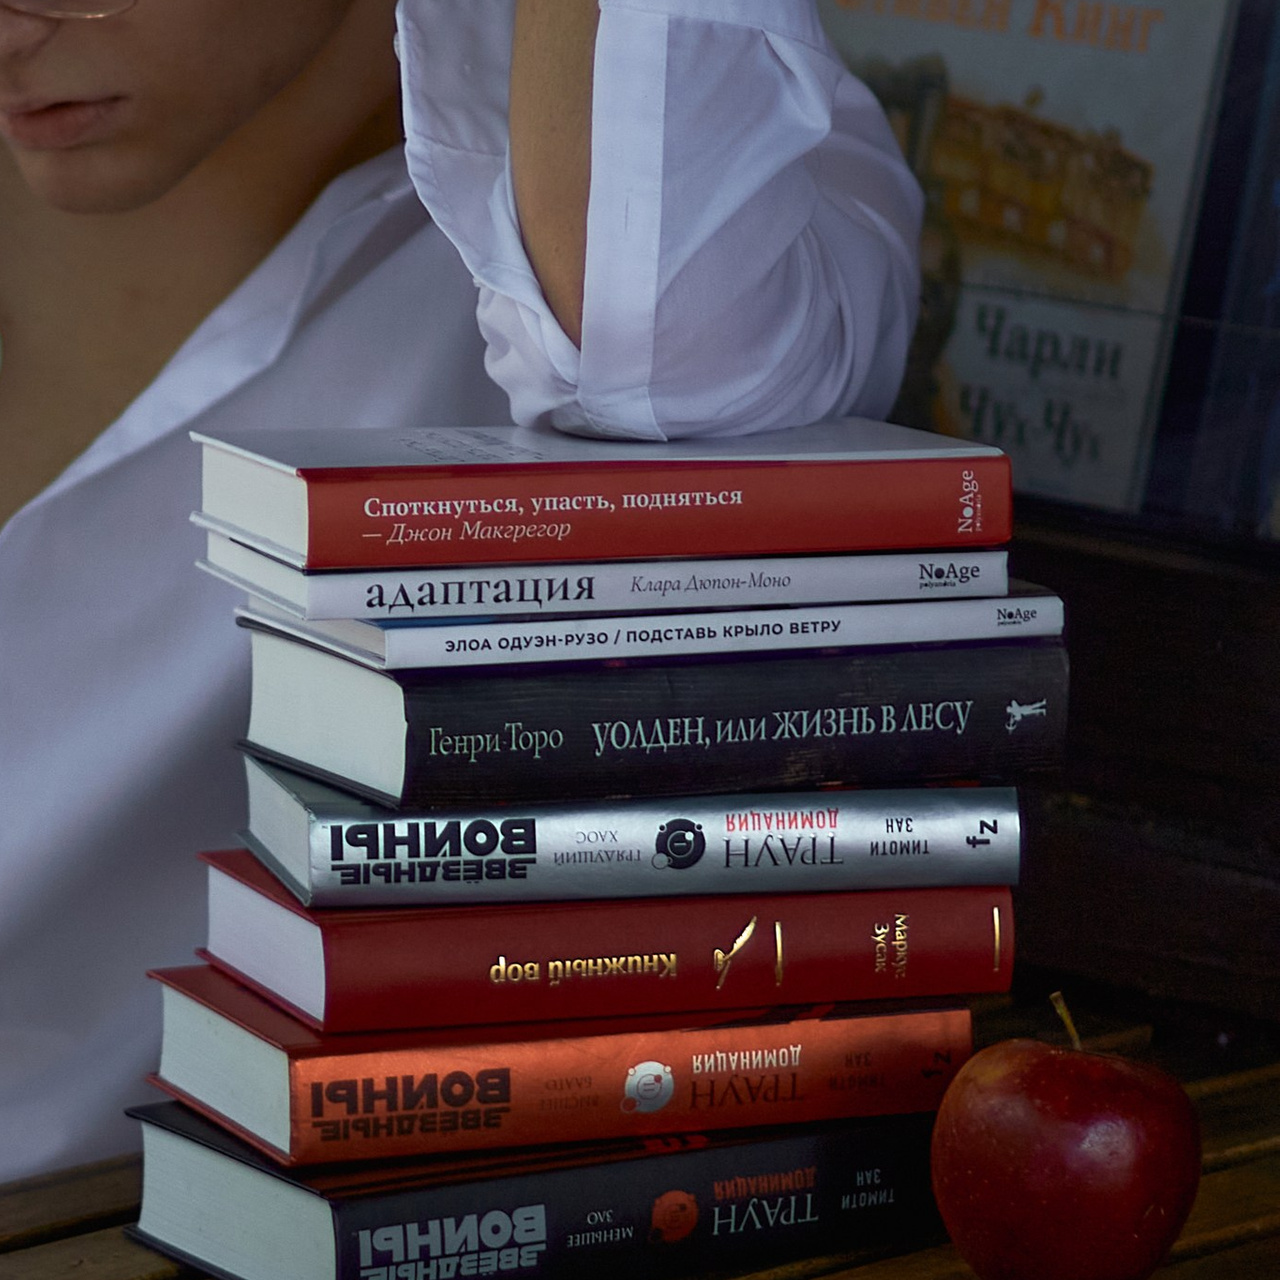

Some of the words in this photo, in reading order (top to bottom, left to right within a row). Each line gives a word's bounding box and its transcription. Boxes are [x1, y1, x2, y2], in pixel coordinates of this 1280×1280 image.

[976, 304, 1122, 379] Чарли
[363, 496, 524, 520] Споткнуться,
[531, 493, 616, 516] упасть,
[621, 490, 743, 511] подняться
[386, 523, 452, 546] Джон
[459, 520, 572, 543] Макгрегор
[366, 576, 596, 613] адаптация
[630, 575, 681, 597] Клара
[684, 572, 792, 593] Дюпон-Моно
[445, 639, 492, 653] ЭЛОА
[498, 632, 609, 651] ОДУЭН-РУЗО
[626, 627, 717, 644] ПОДСТАВЬ
[723, 623, 783, 638] КРЫЛО
[790, 620, 842, 635] ВЕТРУ
[429, 727, 501, 763] Генри
[504, 722, 564, 759] Торо
[591, 716, 711, 757] УОЛДЕН,
[771, 705, 877, 740] ЖИЗНЬ
[880, 704, 897, 733] В
[900, 701, 974, 735] ЛЕСУ
[725, 807, 840, 832] ДОМИНАЦИЯ
[885, 817, 913, 833] ЗАН
[575, 829, 619, 843] ХАОС
[723, 832, 844, 868] ТРАУН
[870, 839, 930, 856] ТИМОТИ
[553, 849, 642, 867] ГРЯДУЩИЙ
[871, 922, 890, 973] Зусак
[489, 955, 540, 983] вор
[548, 952, 678, 987] Книжный
[693, 1044, 802, 1074] ДОМИНАЦИЯ
[690, 1072, 805, 1108] ТРАУН
[713, 1165, 818, 1200] ДОМИНАЦИЯ
[856, 1168, 882, 1187] ЗАН
[840, 1187, 895, 1211] ТИМОТИ
[586, 1209, 614, 1226] ЗЛО
[711, 1193, 820, 1237] ТРАУН
[566, 1226, 635, 1249] МЕНЬШЕЕ
